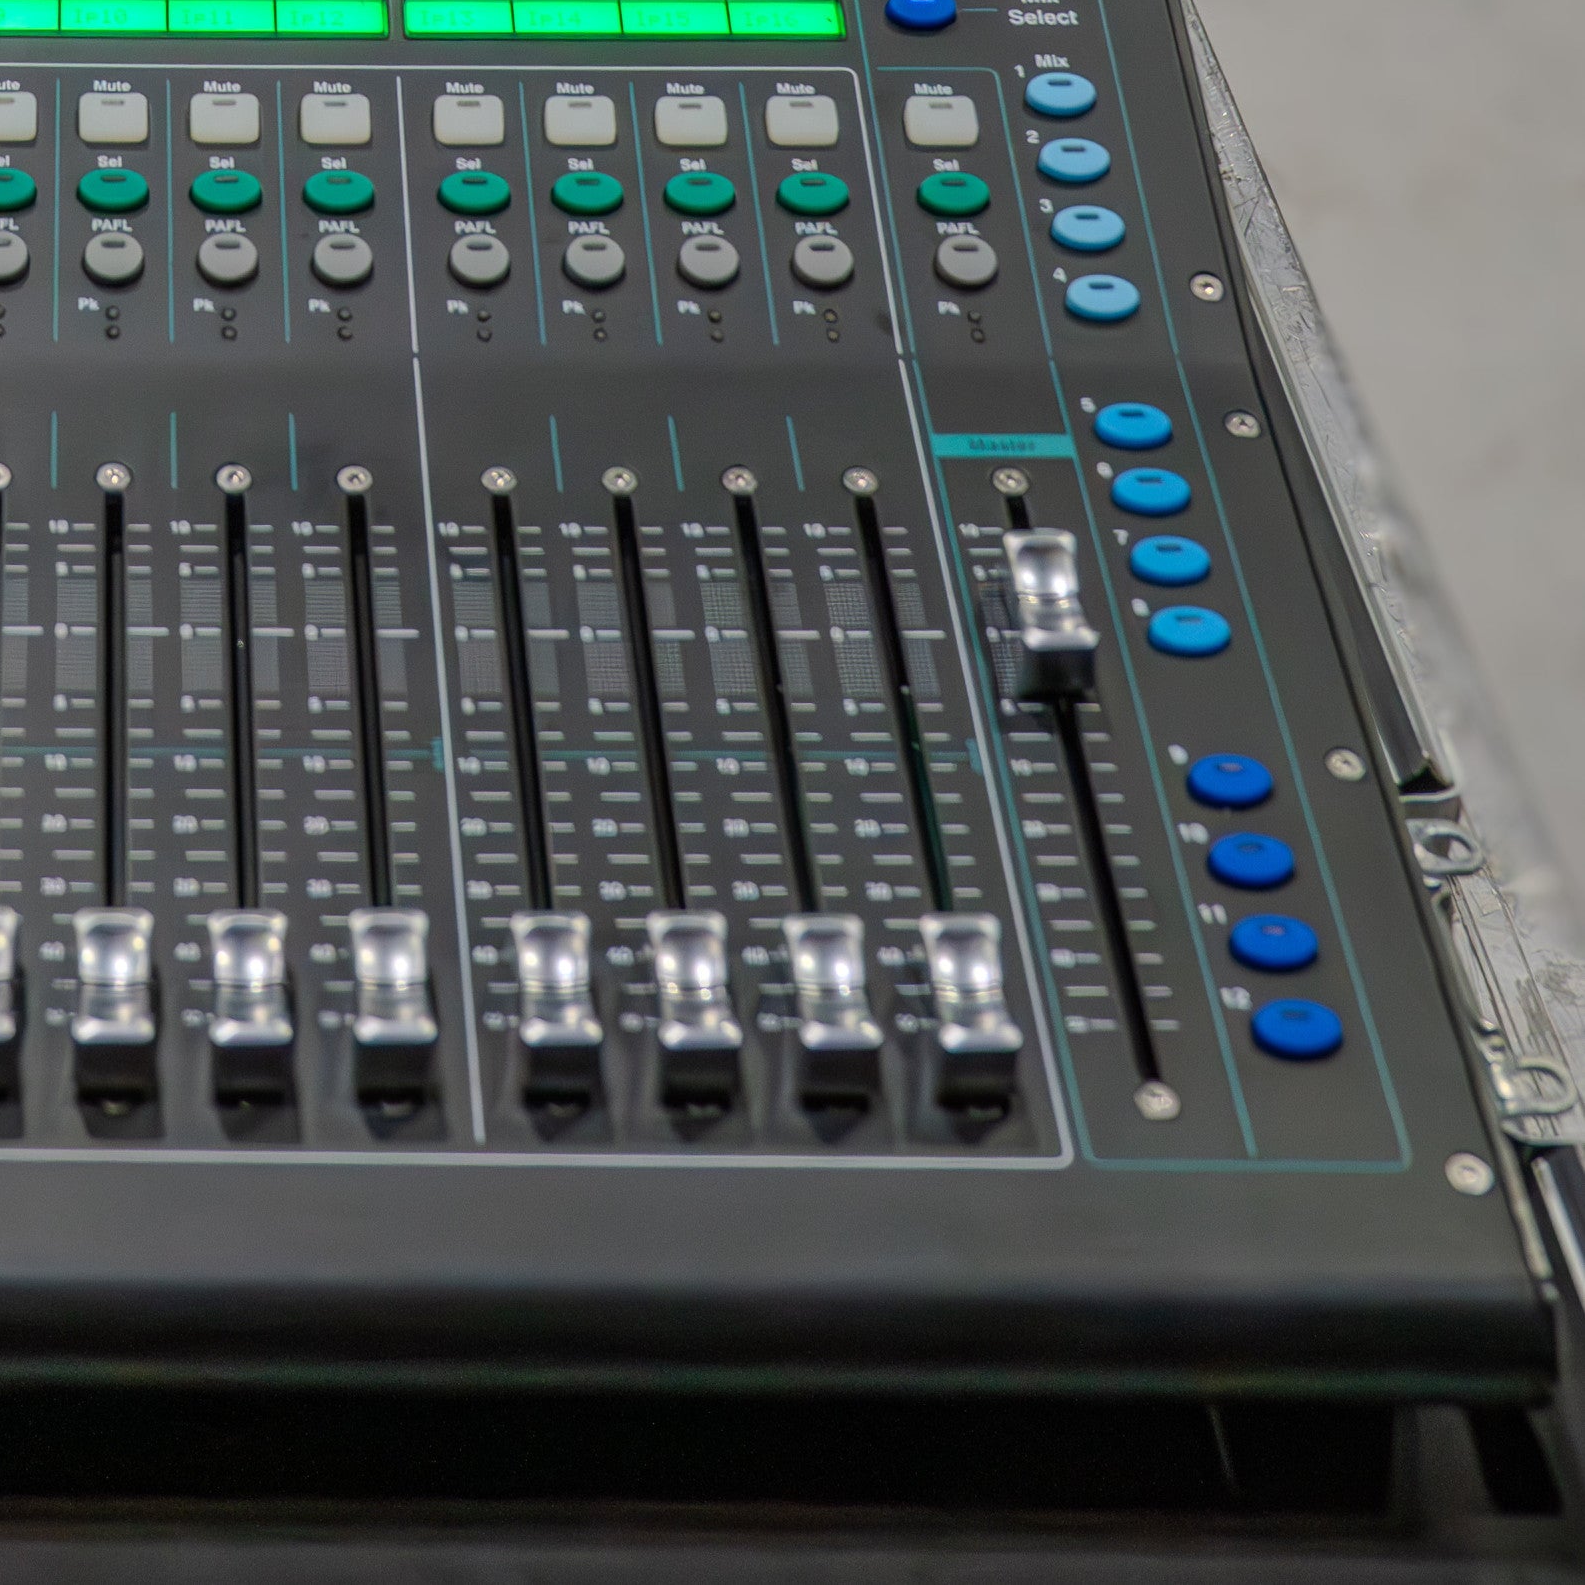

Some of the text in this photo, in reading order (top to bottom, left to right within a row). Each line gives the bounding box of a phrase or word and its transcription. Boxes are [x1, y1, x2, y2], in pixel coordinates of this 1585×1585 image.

[1008, 9, 1079, 26] Select
[1034, 54, 1070, 68] Mix
[1014, 64, 1025, 78] 1
[446, 82, 485, 95] Mute
[915, 83, 953, 95] Mute
[1026, 130, 1040, 144] 2
[1039, 199, 1054, 214] 3
[1052, 267, 1068, 282] 4
